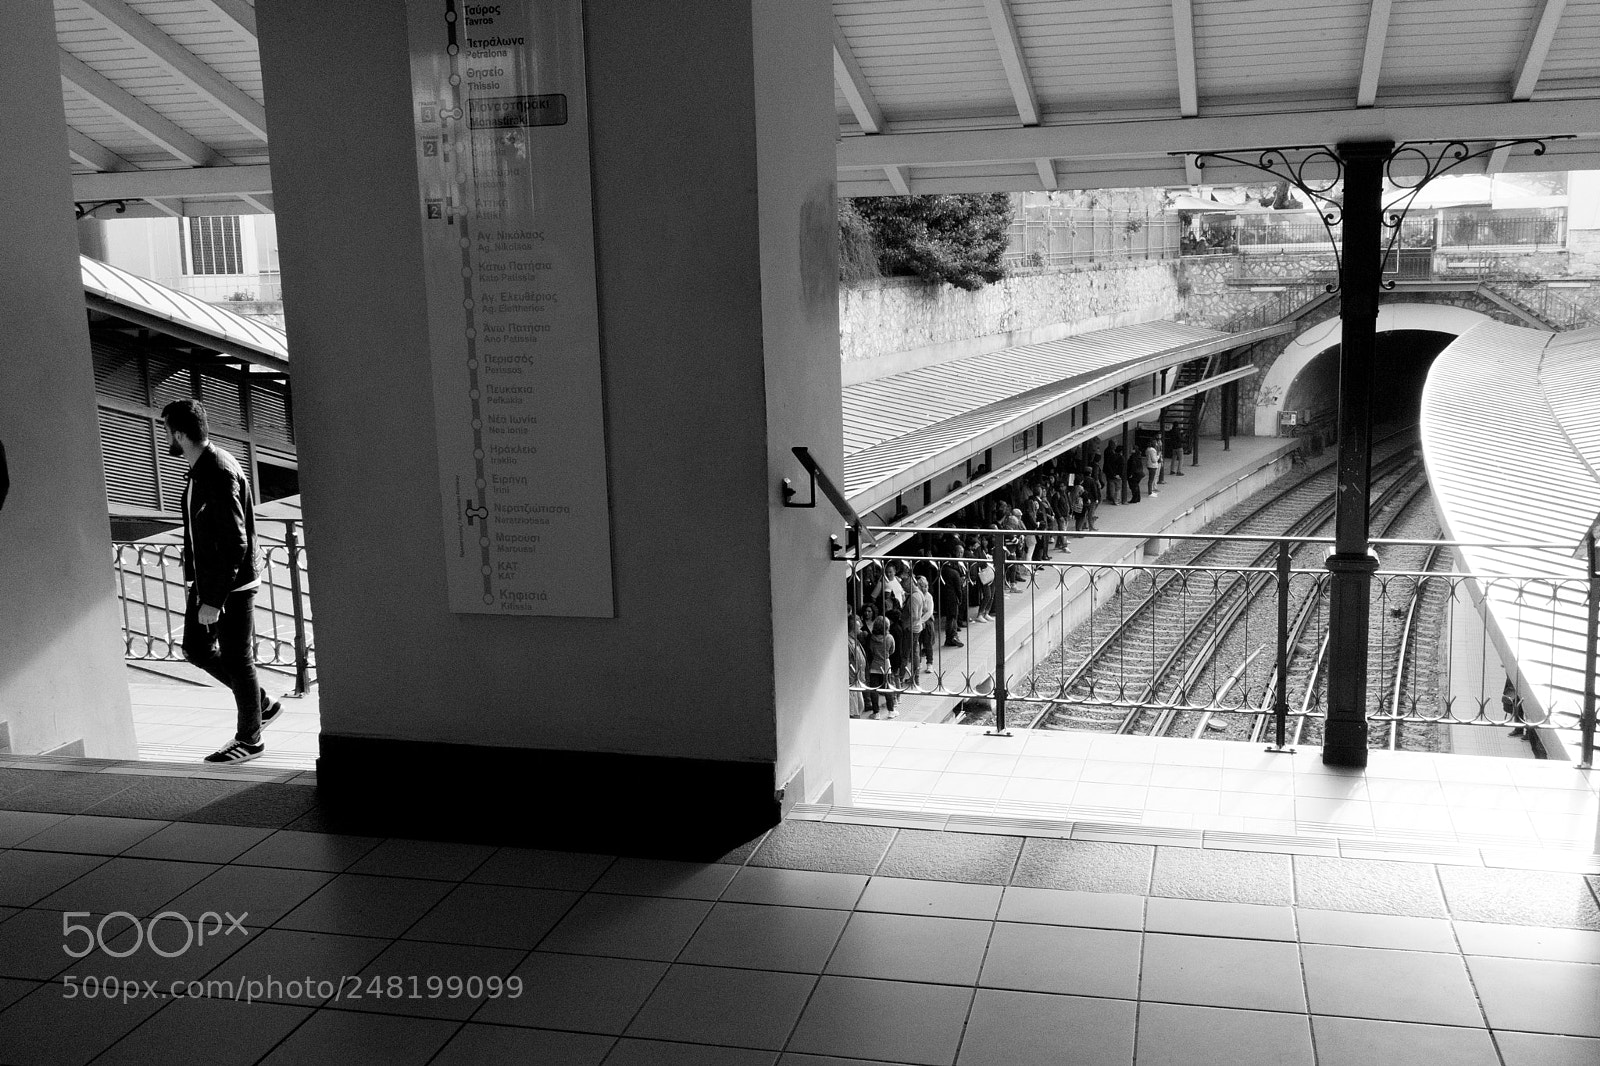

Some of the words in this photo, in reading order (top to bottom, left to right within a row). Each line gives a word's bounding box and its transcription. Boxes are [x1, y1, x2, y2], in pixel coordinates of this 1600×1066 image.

[464, 5, 501, 16] Ταύρος
[465, 17, 494, 26] Tavros
[466, 36, 525, 49] Πετράλωνα
[466, 49, 508, 59] Petralona
[466, 66, 504, 80] Θησείο
[468, 82, 500, 91] Thissio
[497, 230, 545, 241] Νικόλαος
[484, 335, 501, 343] Ano
[484, 354, 534, 366] Περισσός
[485, 366, 522, 374] Perissos
[499, 589, 547, 602] Κηφισιά
